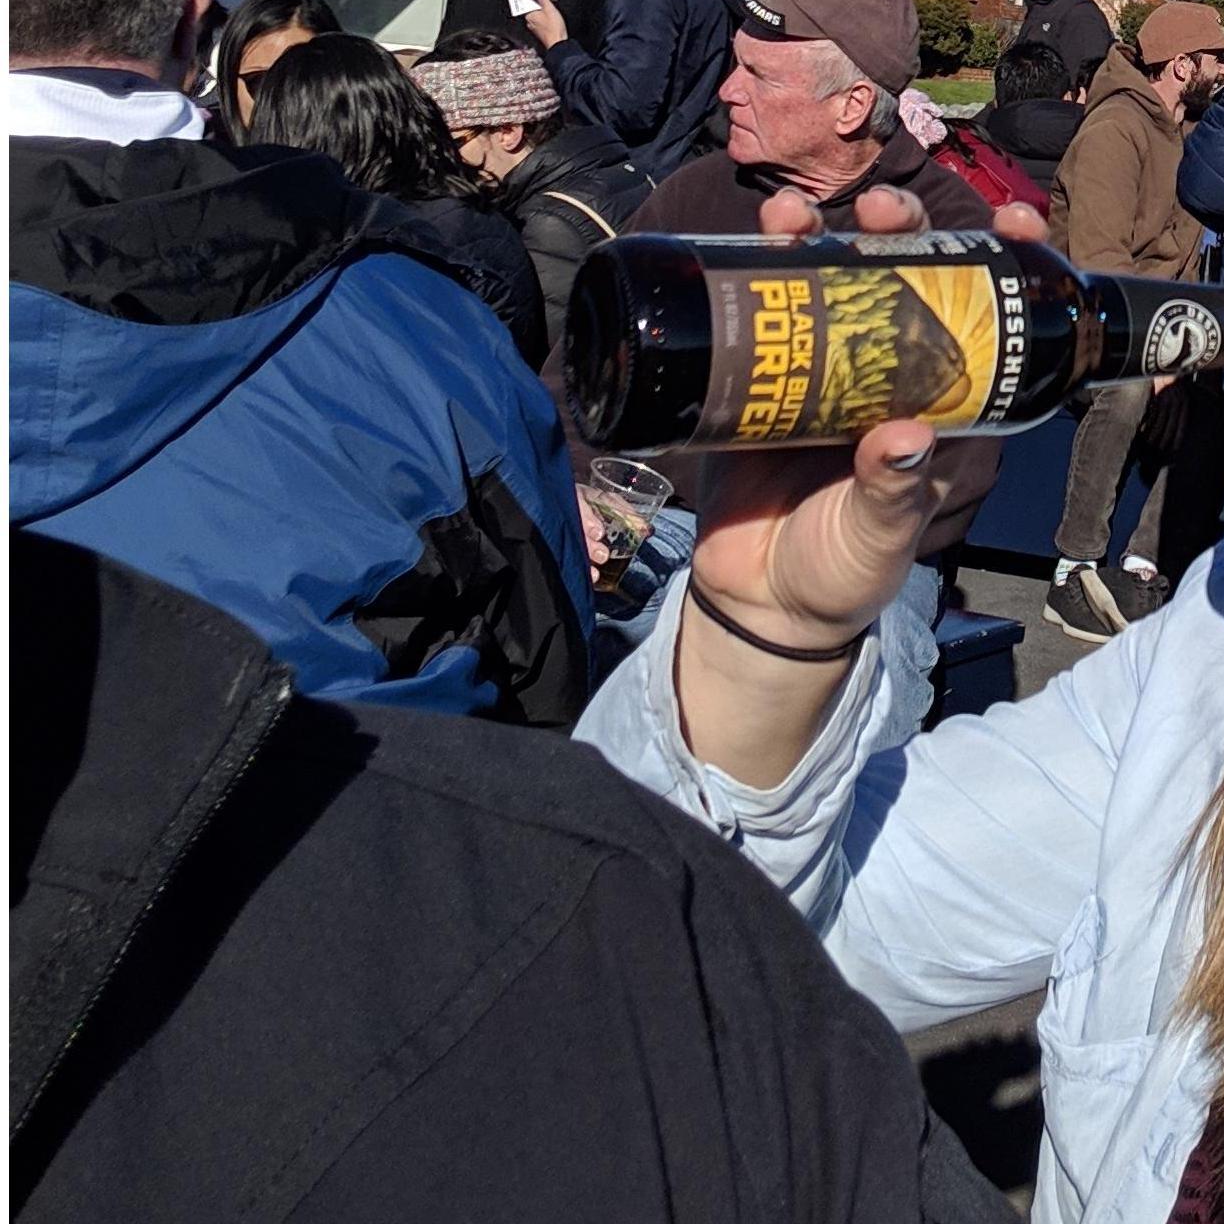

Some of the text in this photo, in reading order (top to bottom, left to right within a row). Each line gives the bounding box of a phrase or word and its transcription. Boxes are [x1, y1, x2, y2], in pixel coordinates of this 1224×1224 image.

[736, 280, 791, 441] PORTER
[769, 279, 814, 441] BLACK BUTTE
